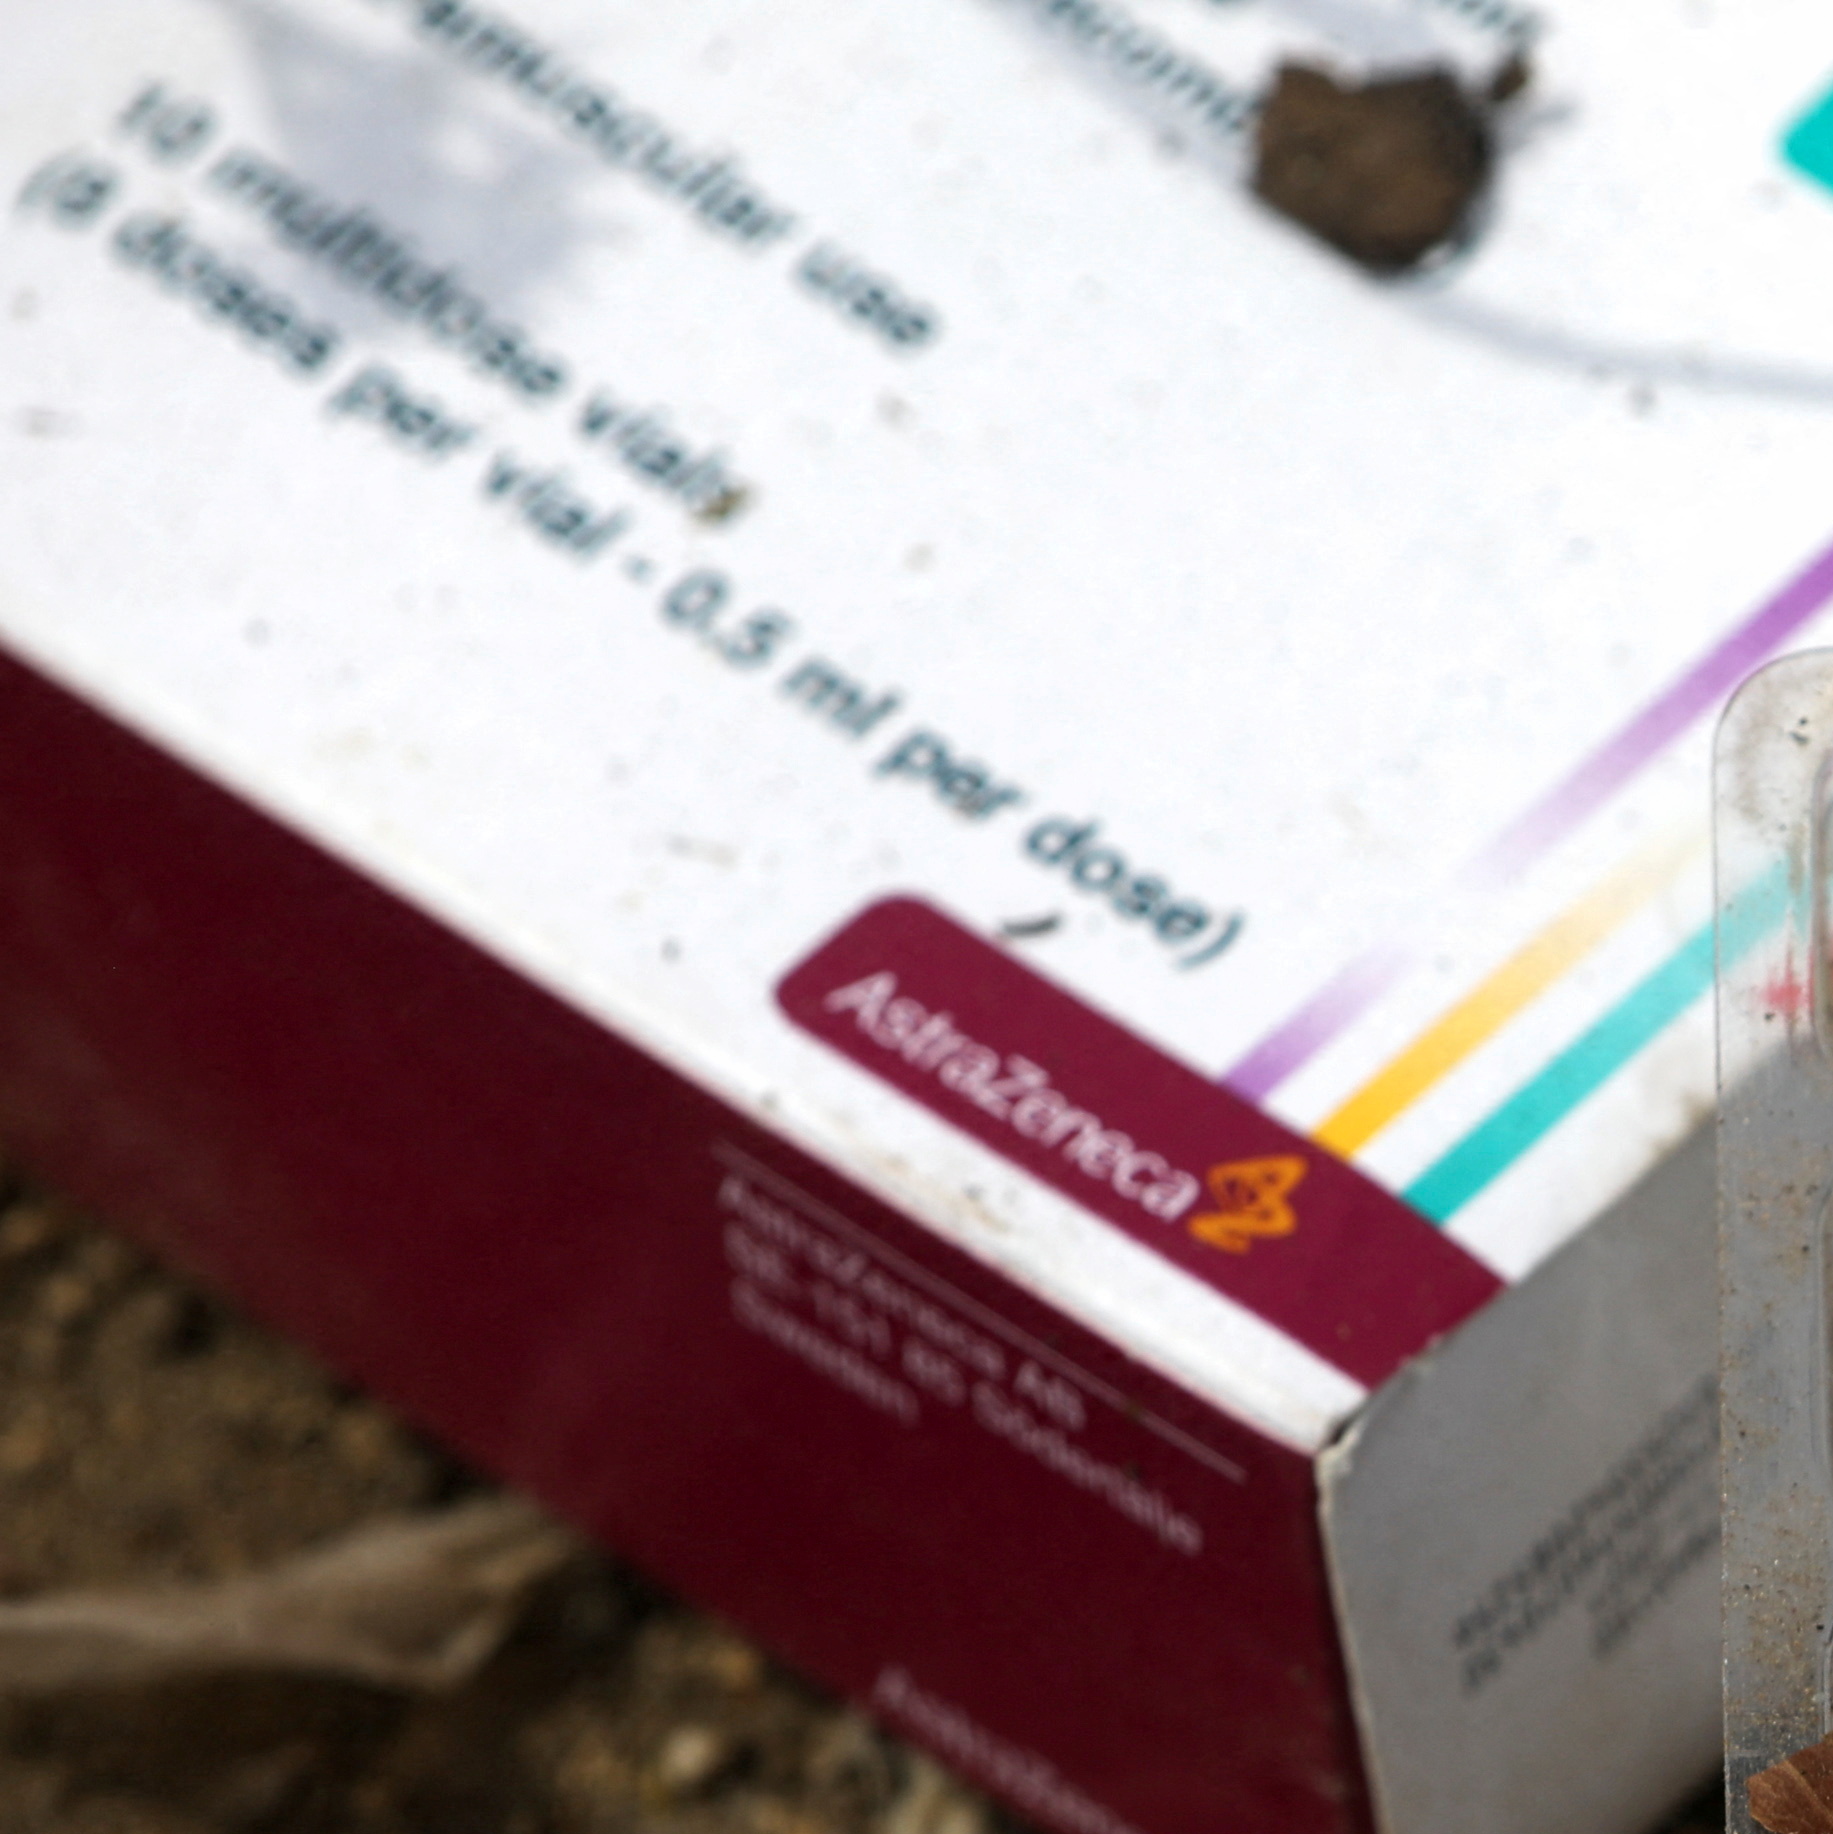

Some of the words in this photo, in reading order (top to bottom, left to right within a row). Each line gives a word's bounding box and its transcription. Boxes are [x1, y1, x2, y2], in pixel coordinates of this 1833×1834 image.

[208, 148, 567, 399] multidose
[793, 240, 941, 348] use
[320, 359, 476, 459] per
[481, 451, 626, 556] vial
[656, 567, 790, 669] 0.5
[781, 651, 899, 738] ml
[870, 724, 1028, 820] per
[1020, 809, 1245, 969] dose)
[823, 970, 1200, 1223] AstraZeneca
